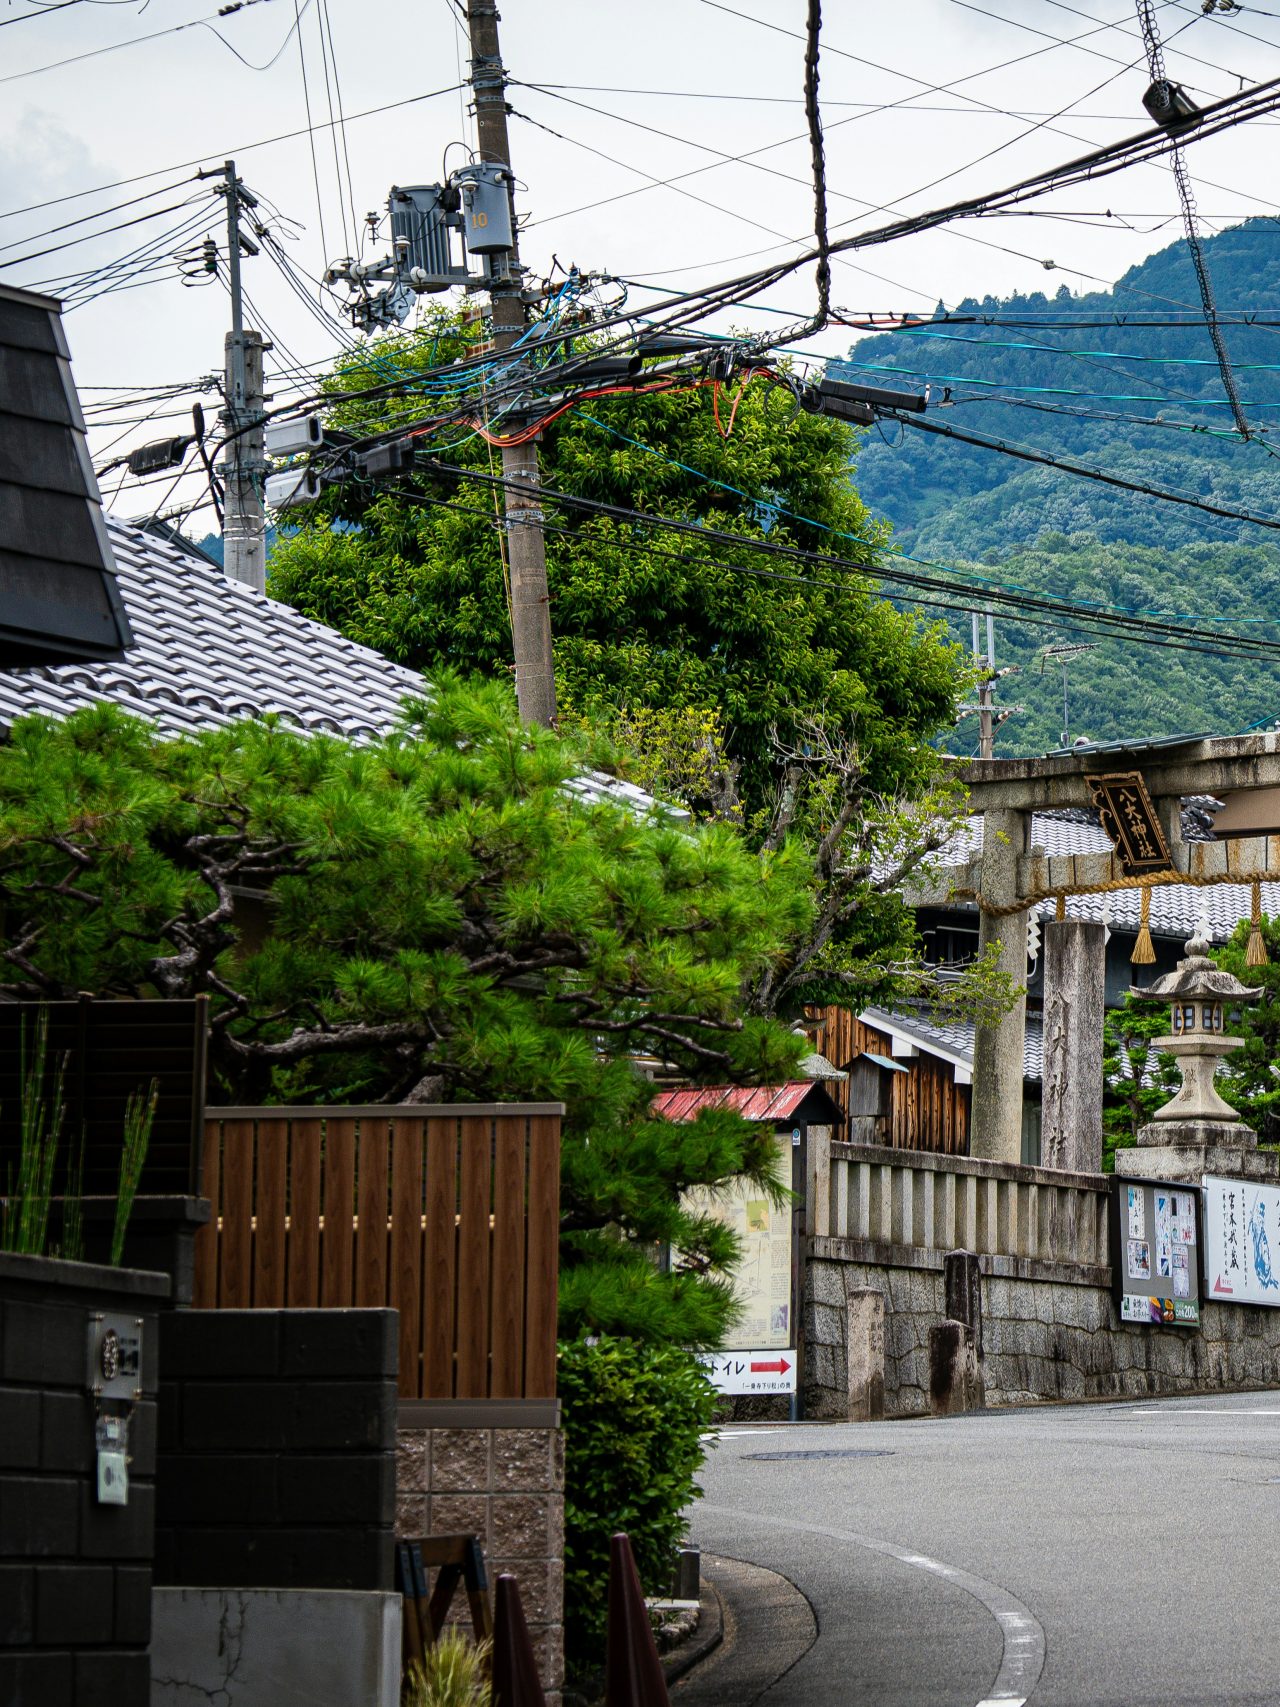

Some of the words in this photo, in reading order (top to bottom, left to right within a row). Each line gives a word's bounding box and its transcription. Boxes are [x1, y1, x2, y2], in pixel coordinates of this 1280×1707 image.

[471, 212, 488, 229] 10
[1118, 788, 1157, 858] 八大神社
[1048, 990, 1070, 1160] 八大神社
[1228, 1192, 1240, 1271] 宮本武蔵
[700, 1360, 745, 1376] トイレ
